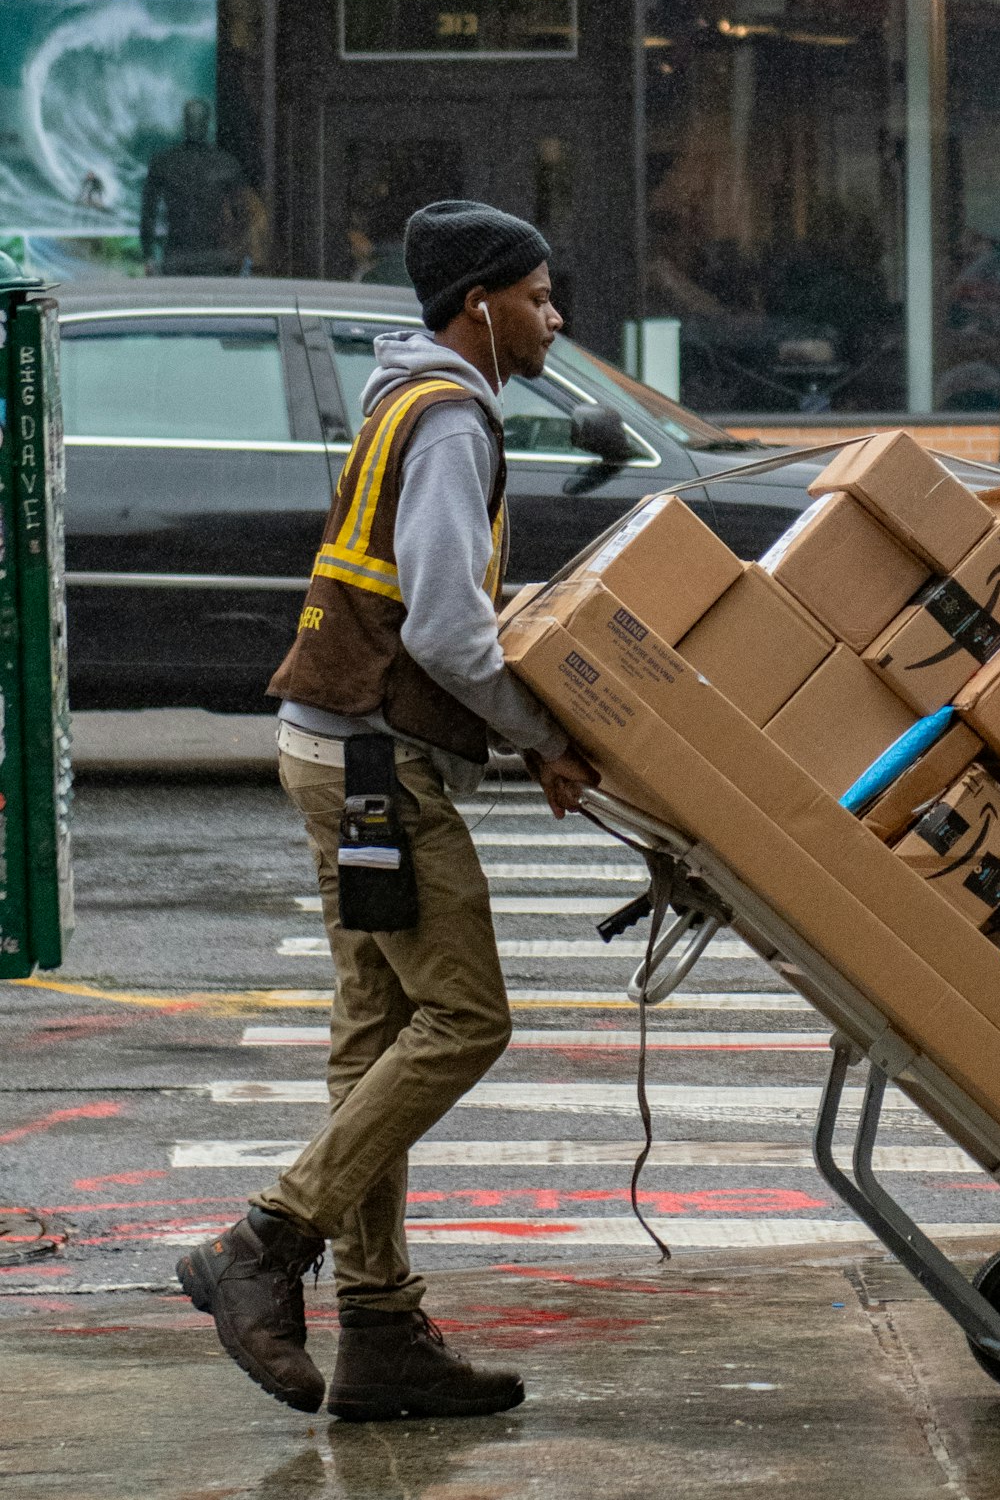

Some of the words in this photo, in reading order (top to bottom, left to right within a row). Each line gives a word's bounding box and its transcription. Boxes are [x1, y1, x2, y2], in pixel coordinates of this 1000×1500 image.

[20, 346, 36, 406] BIG
[20, 414, 41, 530] DAVE
[607, 621, 634, 645] CHROME
[633, 644, 650, 660] WIRE
[648, 656, 675, 684] SHELVING
[615, 610, 648, 641] ULINE
[558, 664, 585, 690] CHROME
[583, 687, 601, 703] WIRE
[599, 700, 627, 727] SHELVING
[566, 653, 599, 684] ULINE
